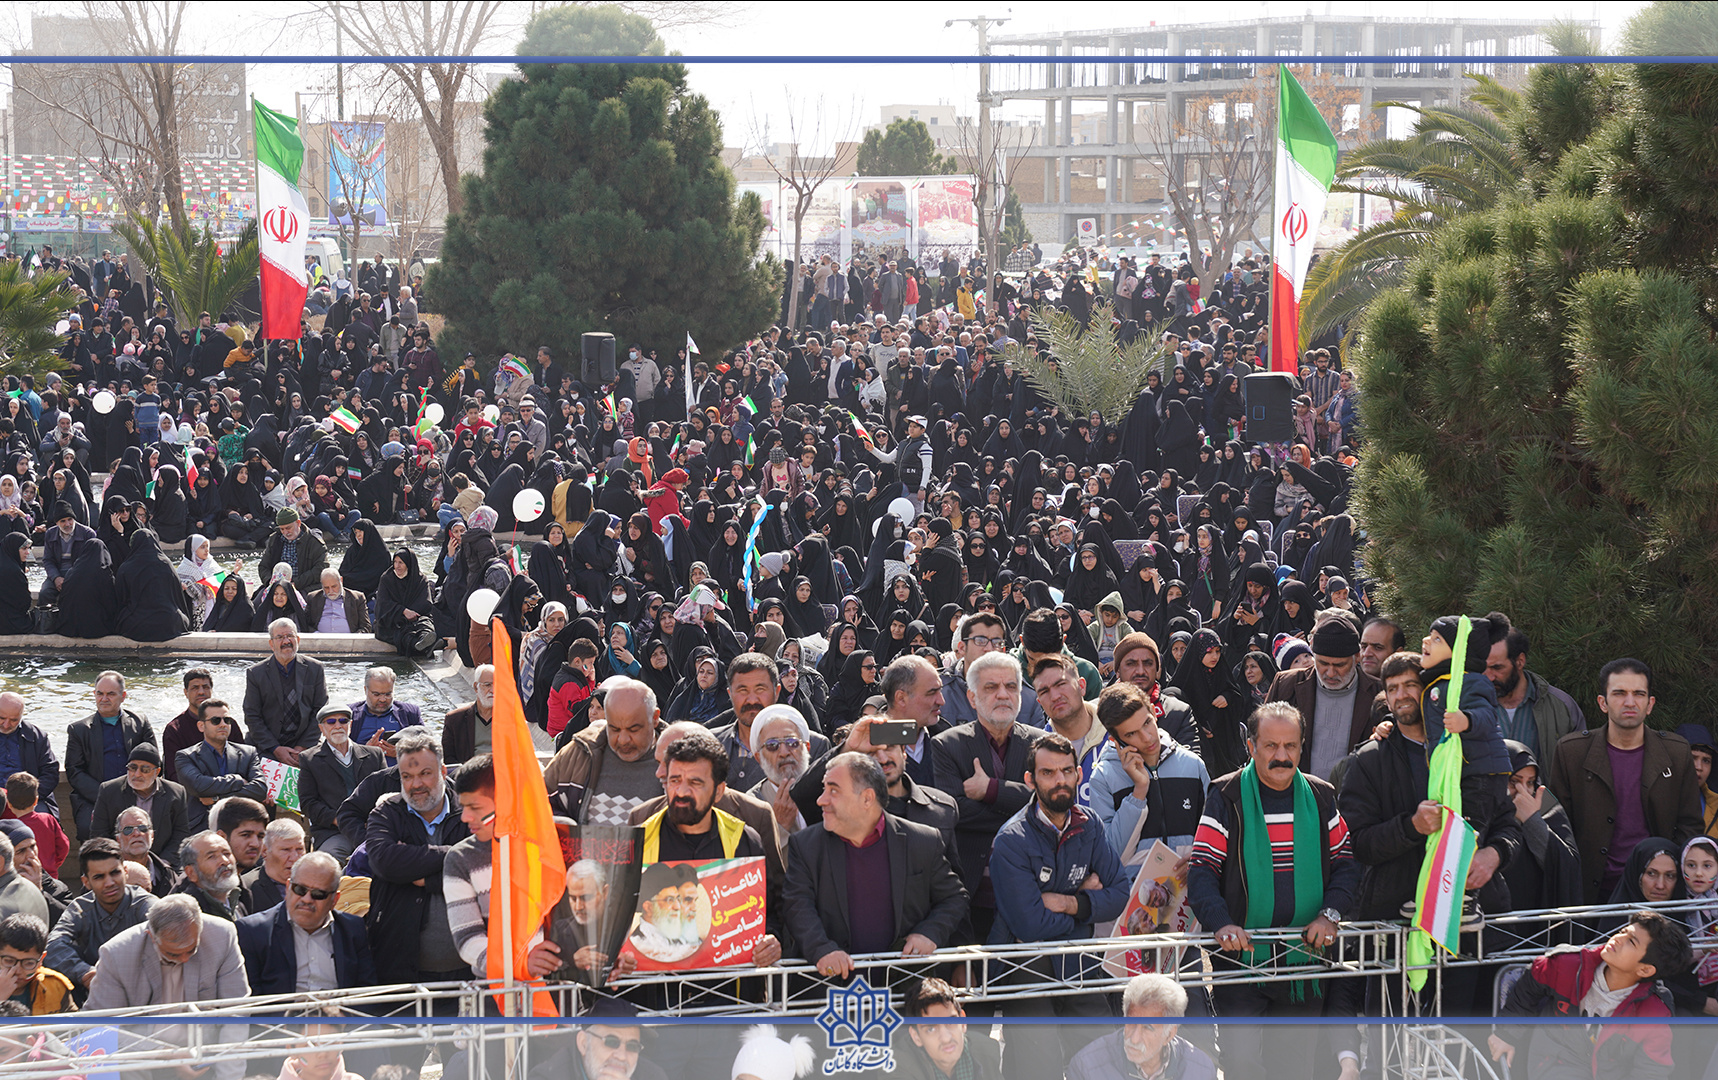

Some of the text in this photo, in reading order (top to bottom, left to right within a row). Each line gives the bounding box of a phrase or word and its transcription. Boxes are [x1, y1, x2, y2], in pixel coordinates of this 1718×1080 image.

[710, 868, 763, 907] اطاعت از
[711, 895, 765, 927] رهبری
[711, 911, 764, 948] ضامن
[713, 942, 742, 964] ماست
